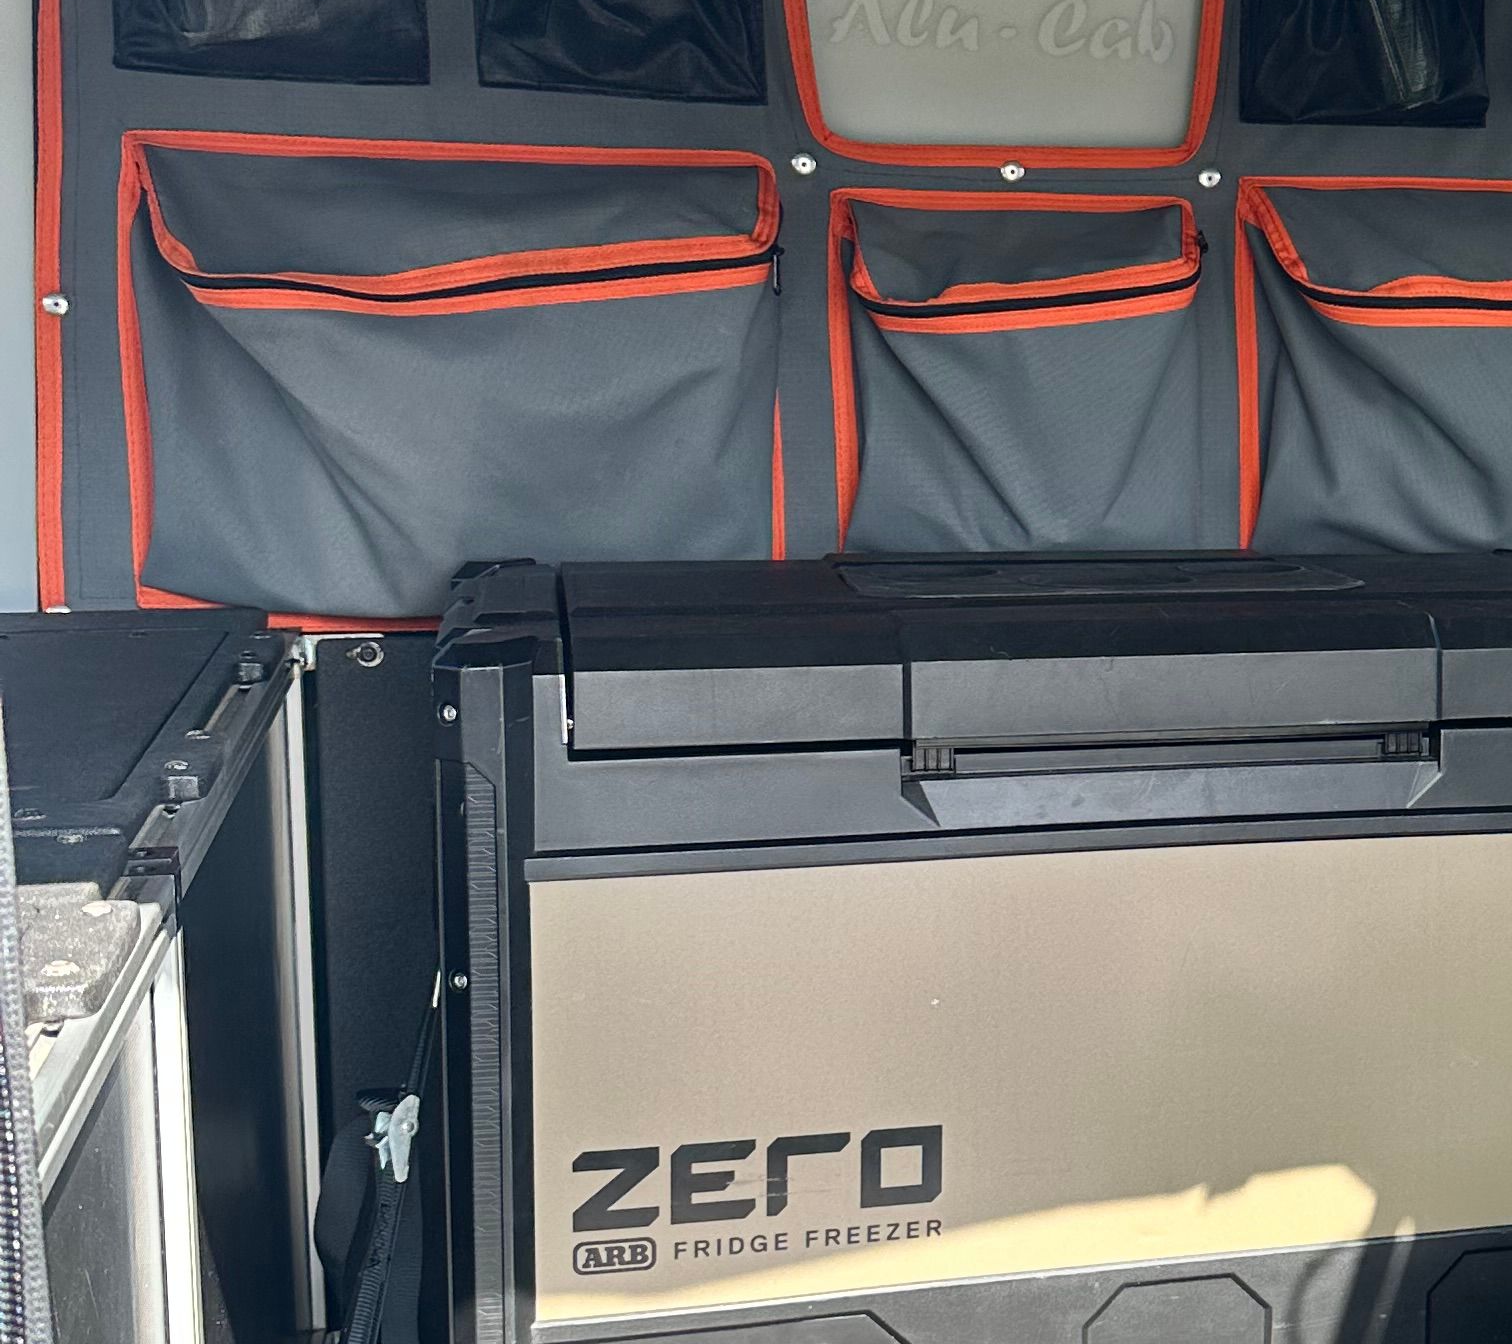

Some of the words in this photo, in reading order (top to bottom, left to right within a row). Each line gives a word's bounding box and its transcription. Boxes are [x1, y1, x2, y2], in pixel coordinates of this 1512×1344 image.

[581, 1242, 650, 1271] ARB
[674, 1232, 789, 1260] FRIDGE
[805, 1219, 943, 1249] FREEZER
